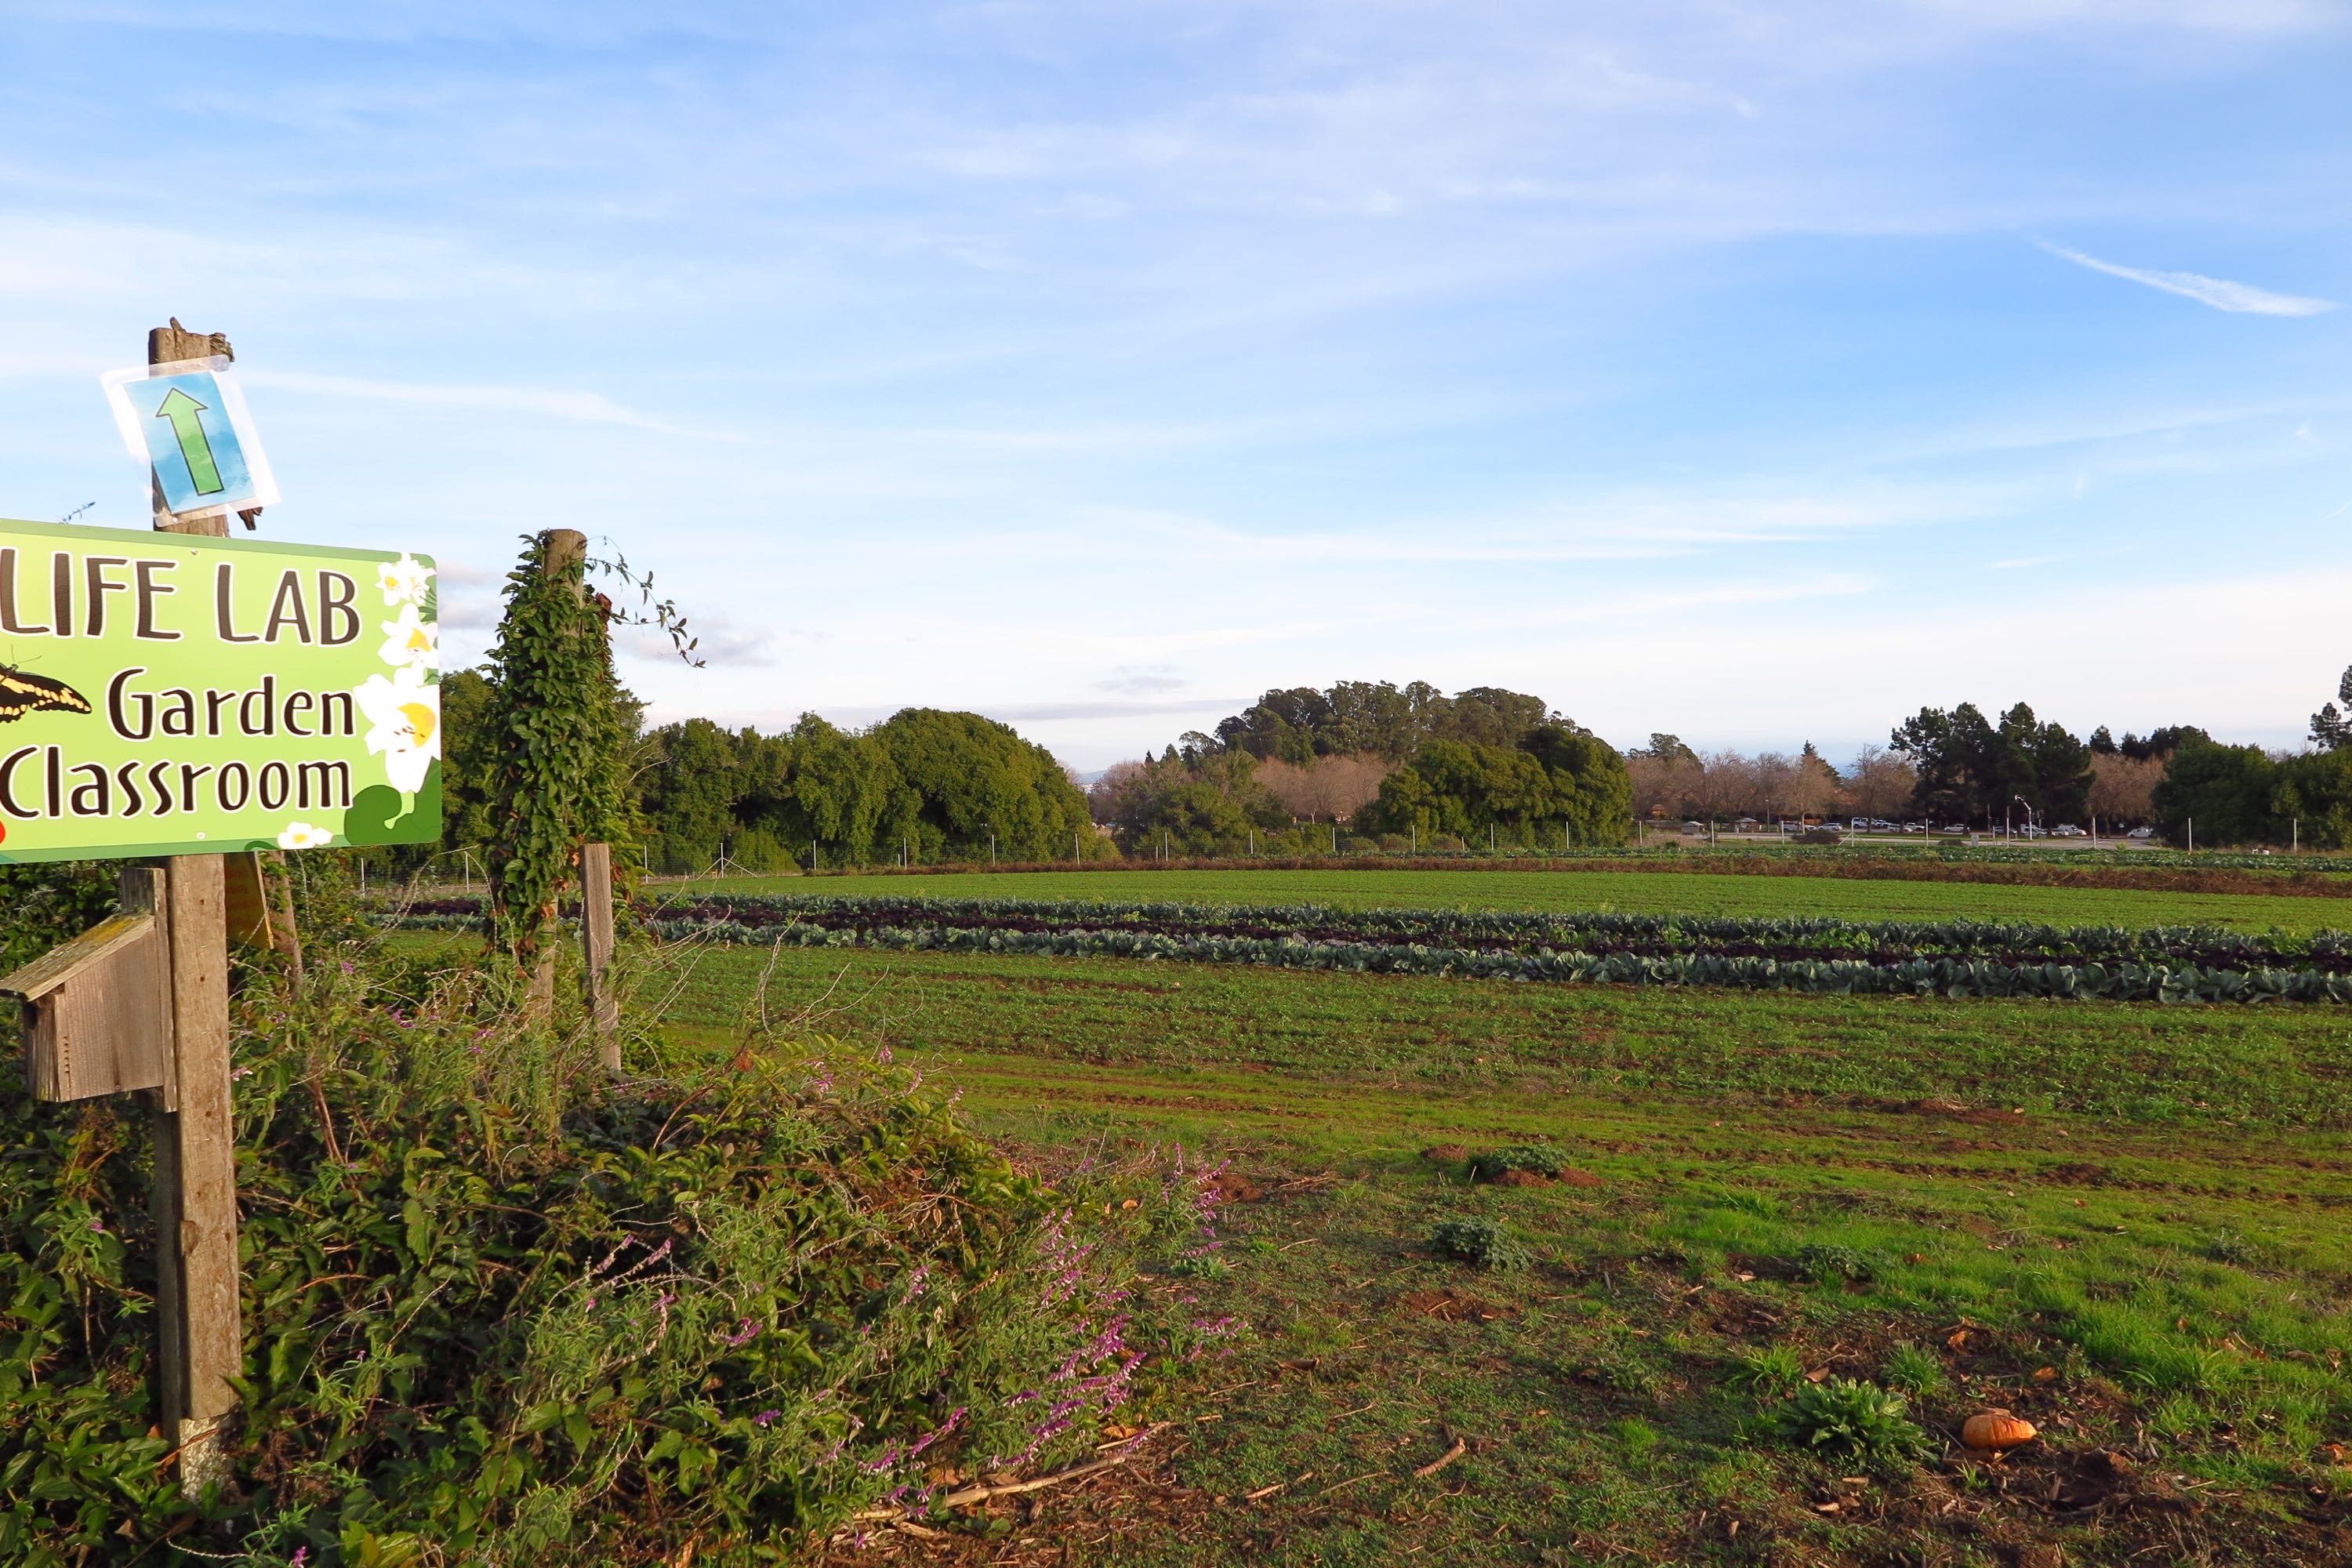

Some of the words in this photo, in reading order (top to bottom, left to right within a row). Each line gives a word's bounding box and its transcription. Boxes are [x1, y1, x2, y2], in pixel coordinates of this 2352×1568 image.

[0, 548, 182, 639] LIFE
[218, 564, 360, 645] LAB
[109, 668, 354, 739] Garden
[0, 746, 351, 818] Classroom
